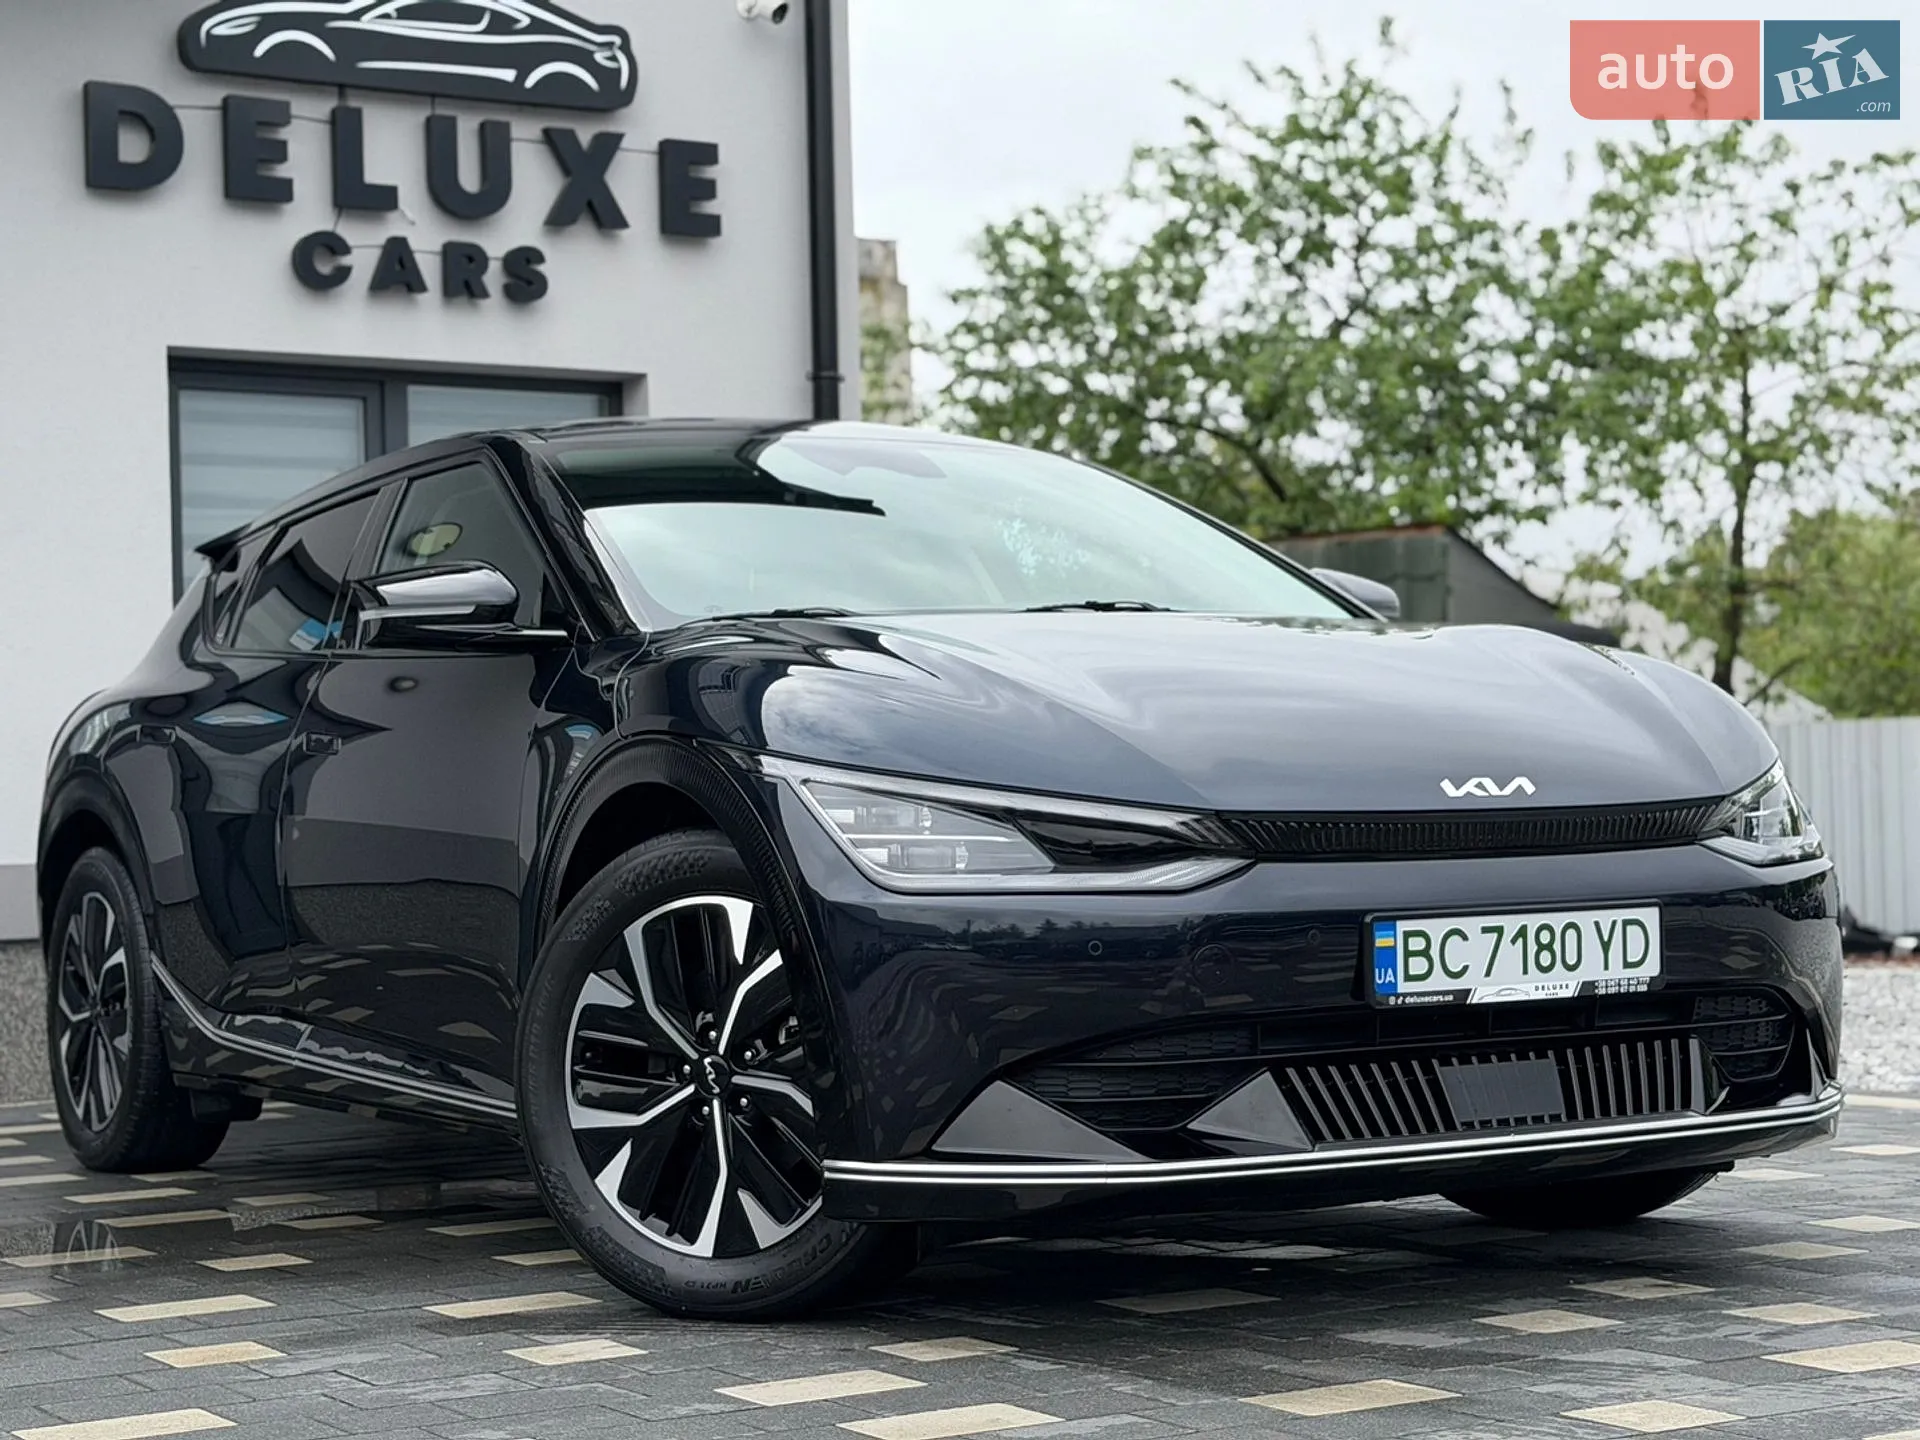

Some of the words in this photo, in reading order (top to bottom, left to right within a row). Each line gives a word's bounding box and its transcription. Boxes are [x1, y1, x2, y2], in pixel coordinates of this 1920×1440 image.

[83, 80, 722, 238] DELUXE
[291, 230, 549, 303] CARS
[1439, 776, 1536, 798] KIA
[1402, 928, 1470, 983] BC
[1480, 921, 1583, 978] 7180
[1594, 917, 1650, 971] YD
[1375, 967, 1396, 985] UA
[1534, 983, 1570, 992] DELUXE
